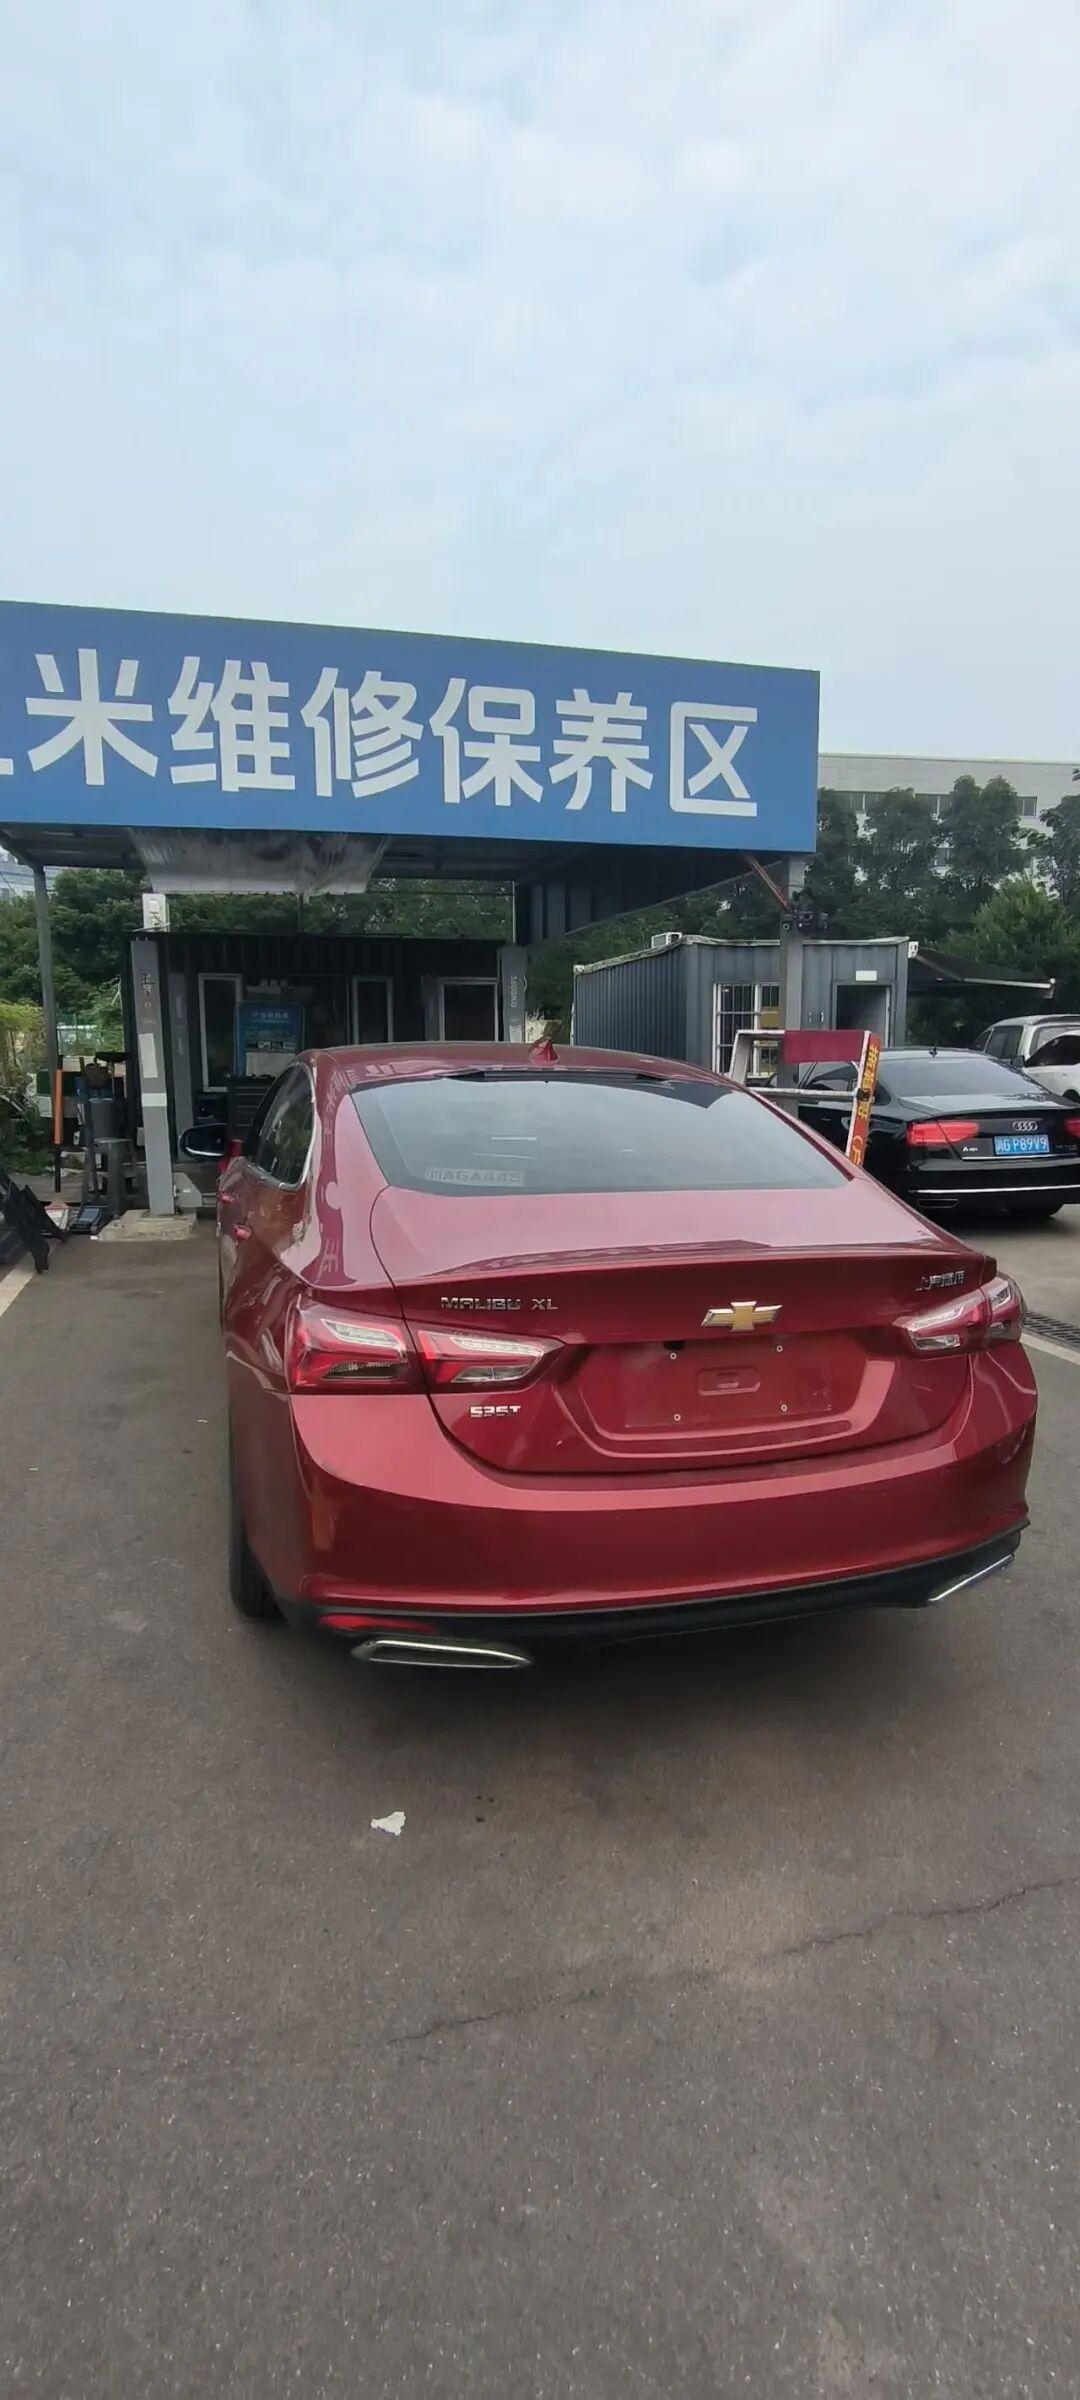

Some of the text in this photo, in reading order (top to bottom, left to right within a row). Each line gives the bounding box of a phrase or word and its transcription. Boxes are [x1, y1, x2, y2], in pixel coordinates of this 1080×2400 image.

[0, 647, 758, 818] 米维修保养区
[440, 1297, 558, 1310] MALIBU XL
[470, 1405, 521, 1418] 535T
